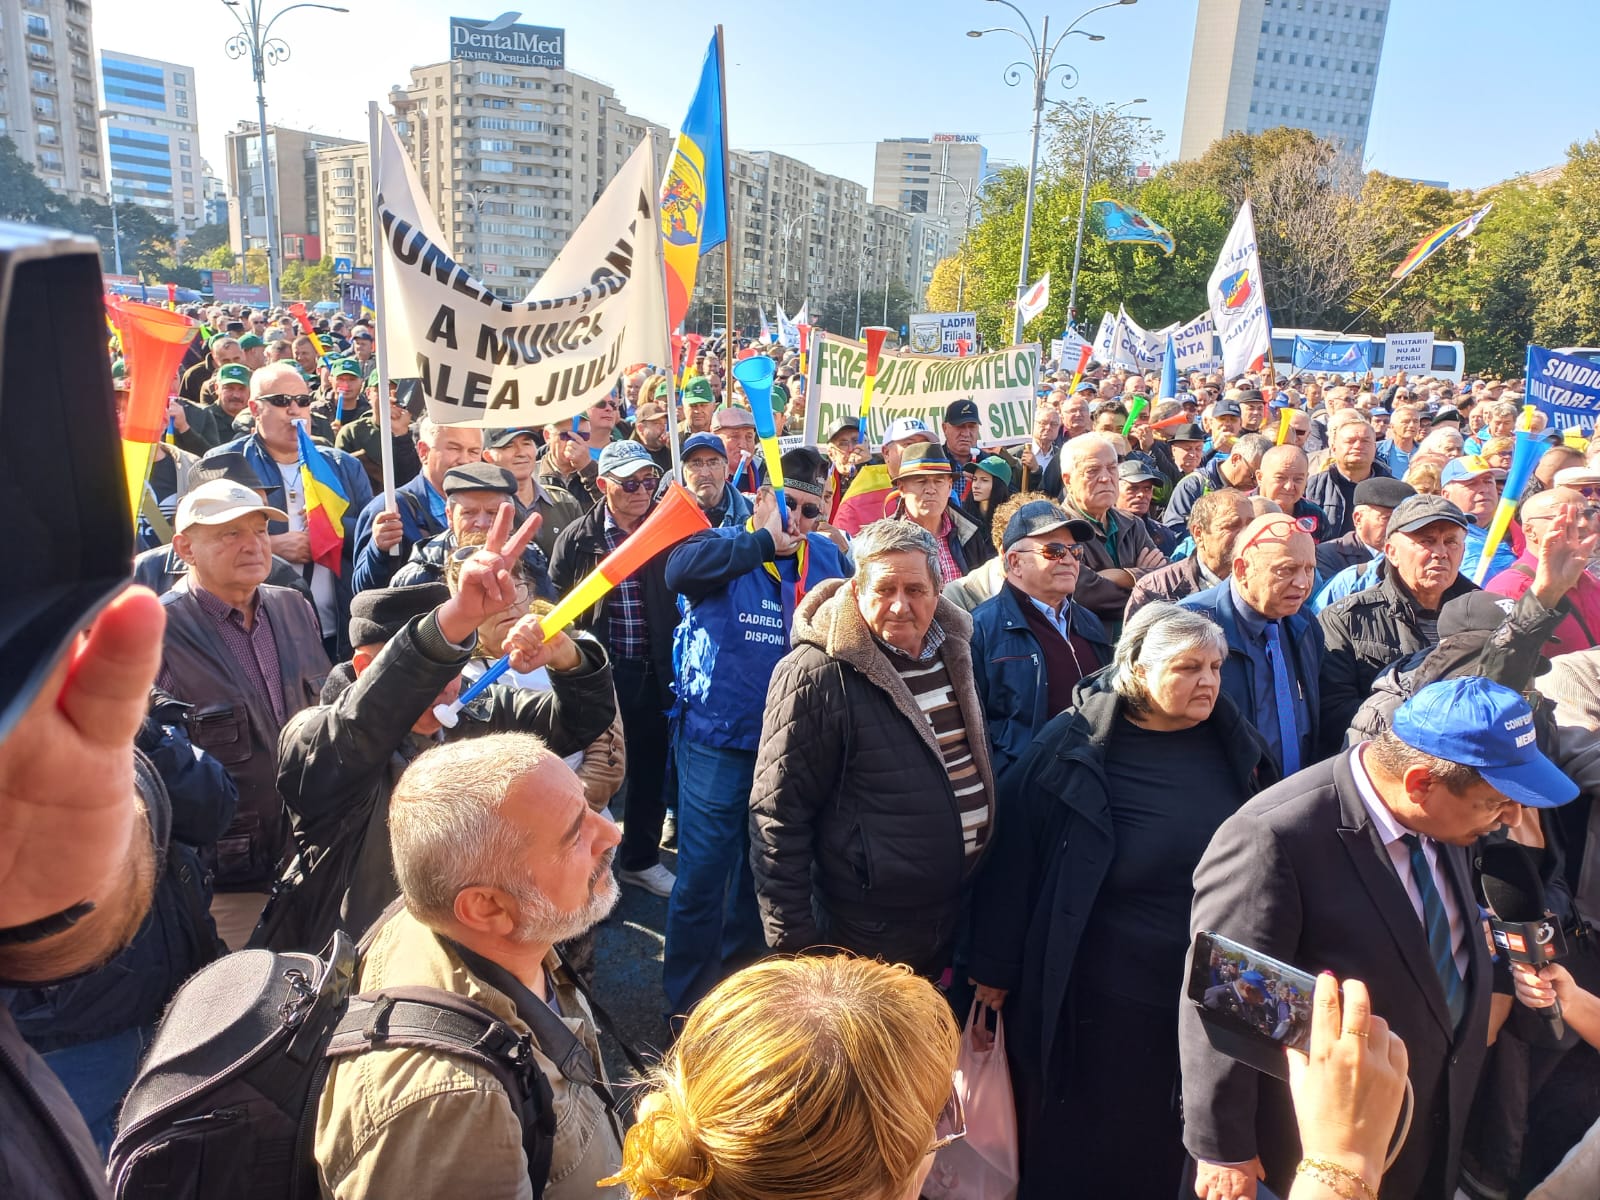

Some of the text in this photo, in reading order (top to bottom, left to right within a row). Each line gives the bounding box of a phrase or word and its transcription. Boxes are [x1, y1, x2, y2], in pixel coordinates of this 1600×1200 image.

[453, 26, 562, 55] DentalMed
[934, 134, 978, 142] FIRSTBANK
[426, 304, 458, 350] A
[941, 318, 975, 328] LADPM
[944, 330, 972, 341] Filiala
[1530, 378, 1596, 409] MILITARE
[904, 419, 926, 431] IPA
